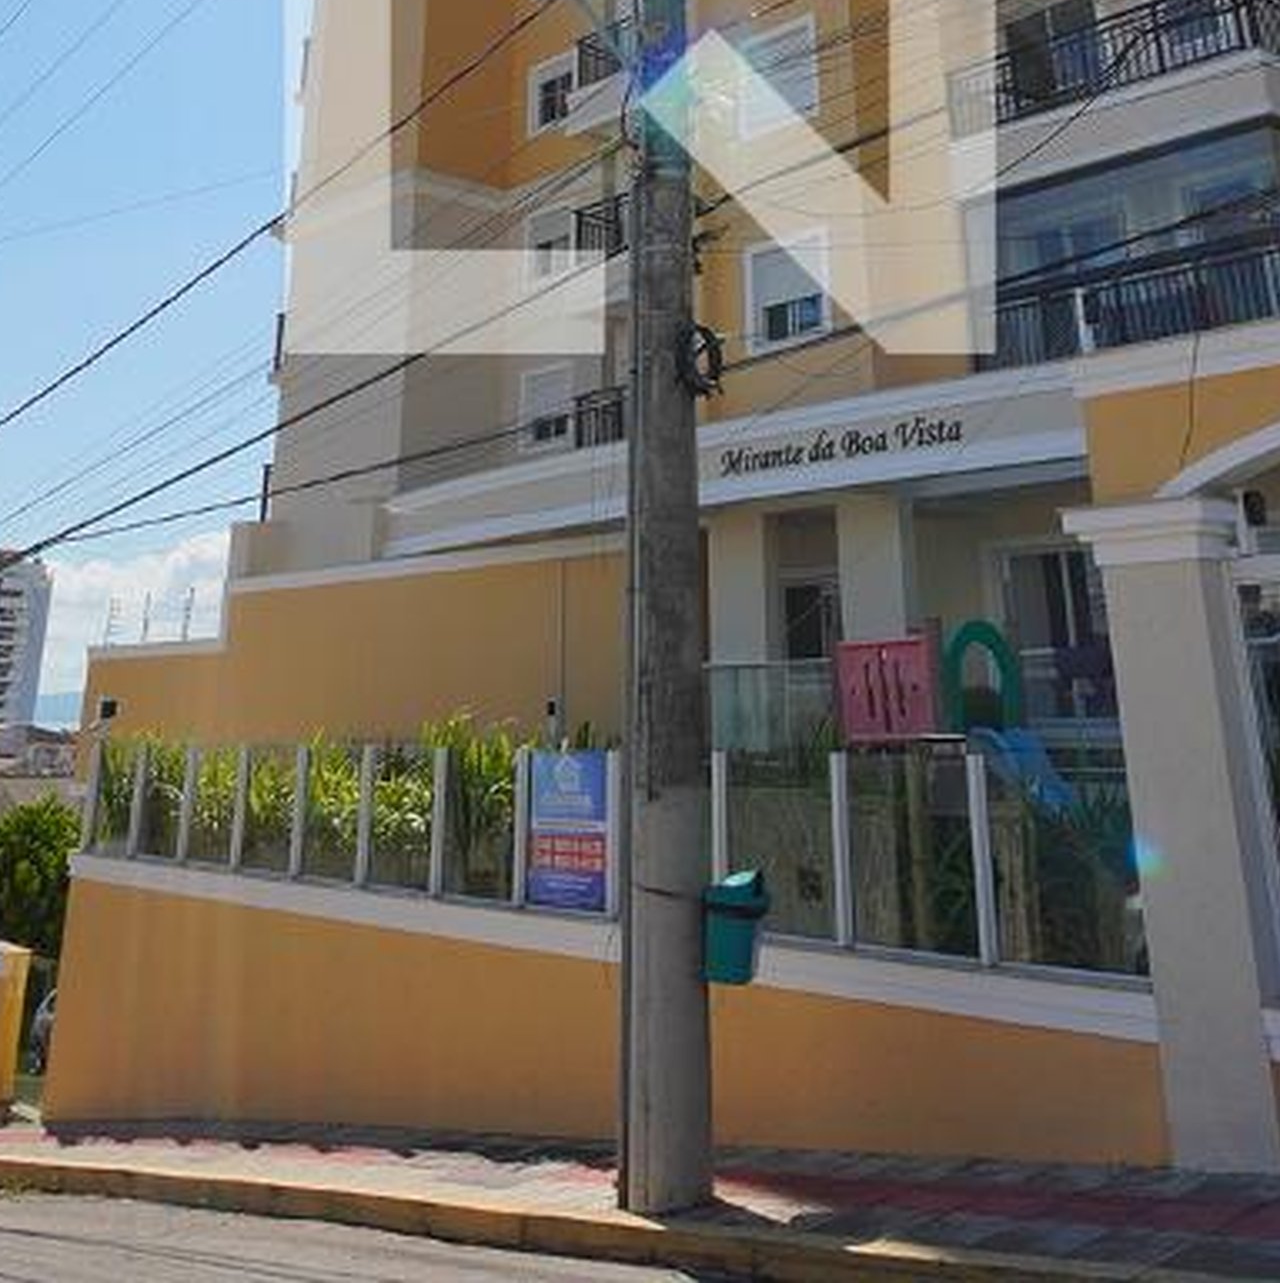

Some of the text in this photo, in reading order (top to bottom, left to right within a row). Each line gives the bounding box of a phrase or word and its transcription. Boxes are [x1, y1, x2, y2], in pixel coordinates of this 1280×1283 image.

[721, 416, 963, 477] Mirante da Boa Vista
